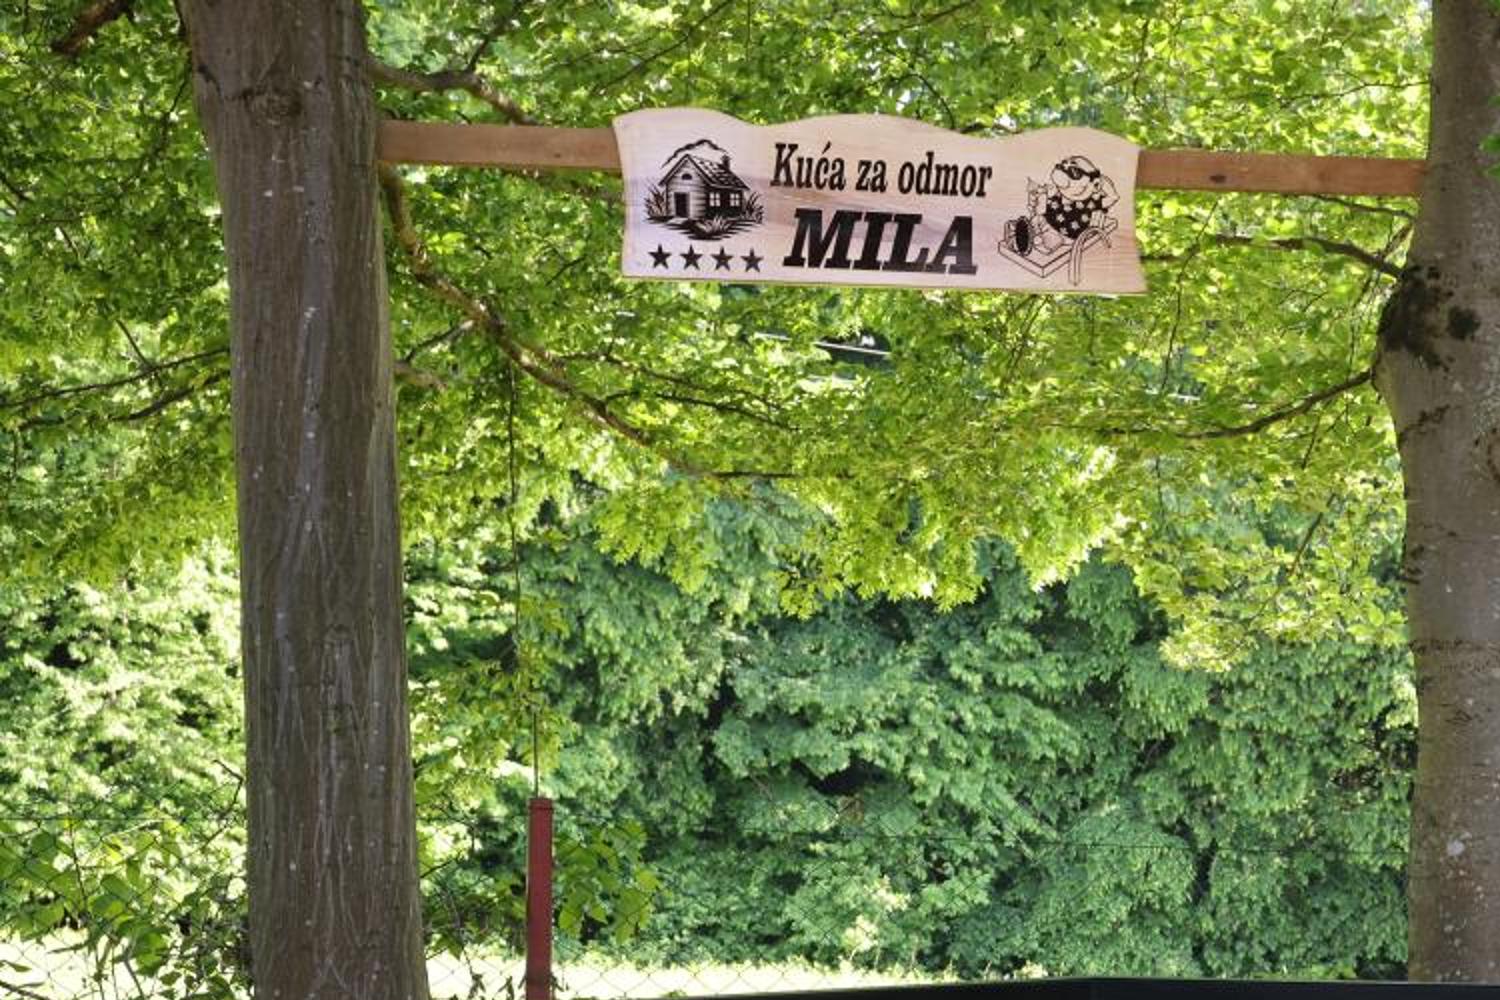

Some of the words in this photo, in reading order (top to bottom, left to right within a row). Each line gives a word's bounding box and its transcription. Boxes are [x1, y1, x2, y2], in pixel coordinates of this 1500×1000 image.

[769, 142, 847, 192] Kuća
[854, 159, 888, 194] za
[897, 151, 993, 198] odmor
[782, 207, 978, 275] MILA
